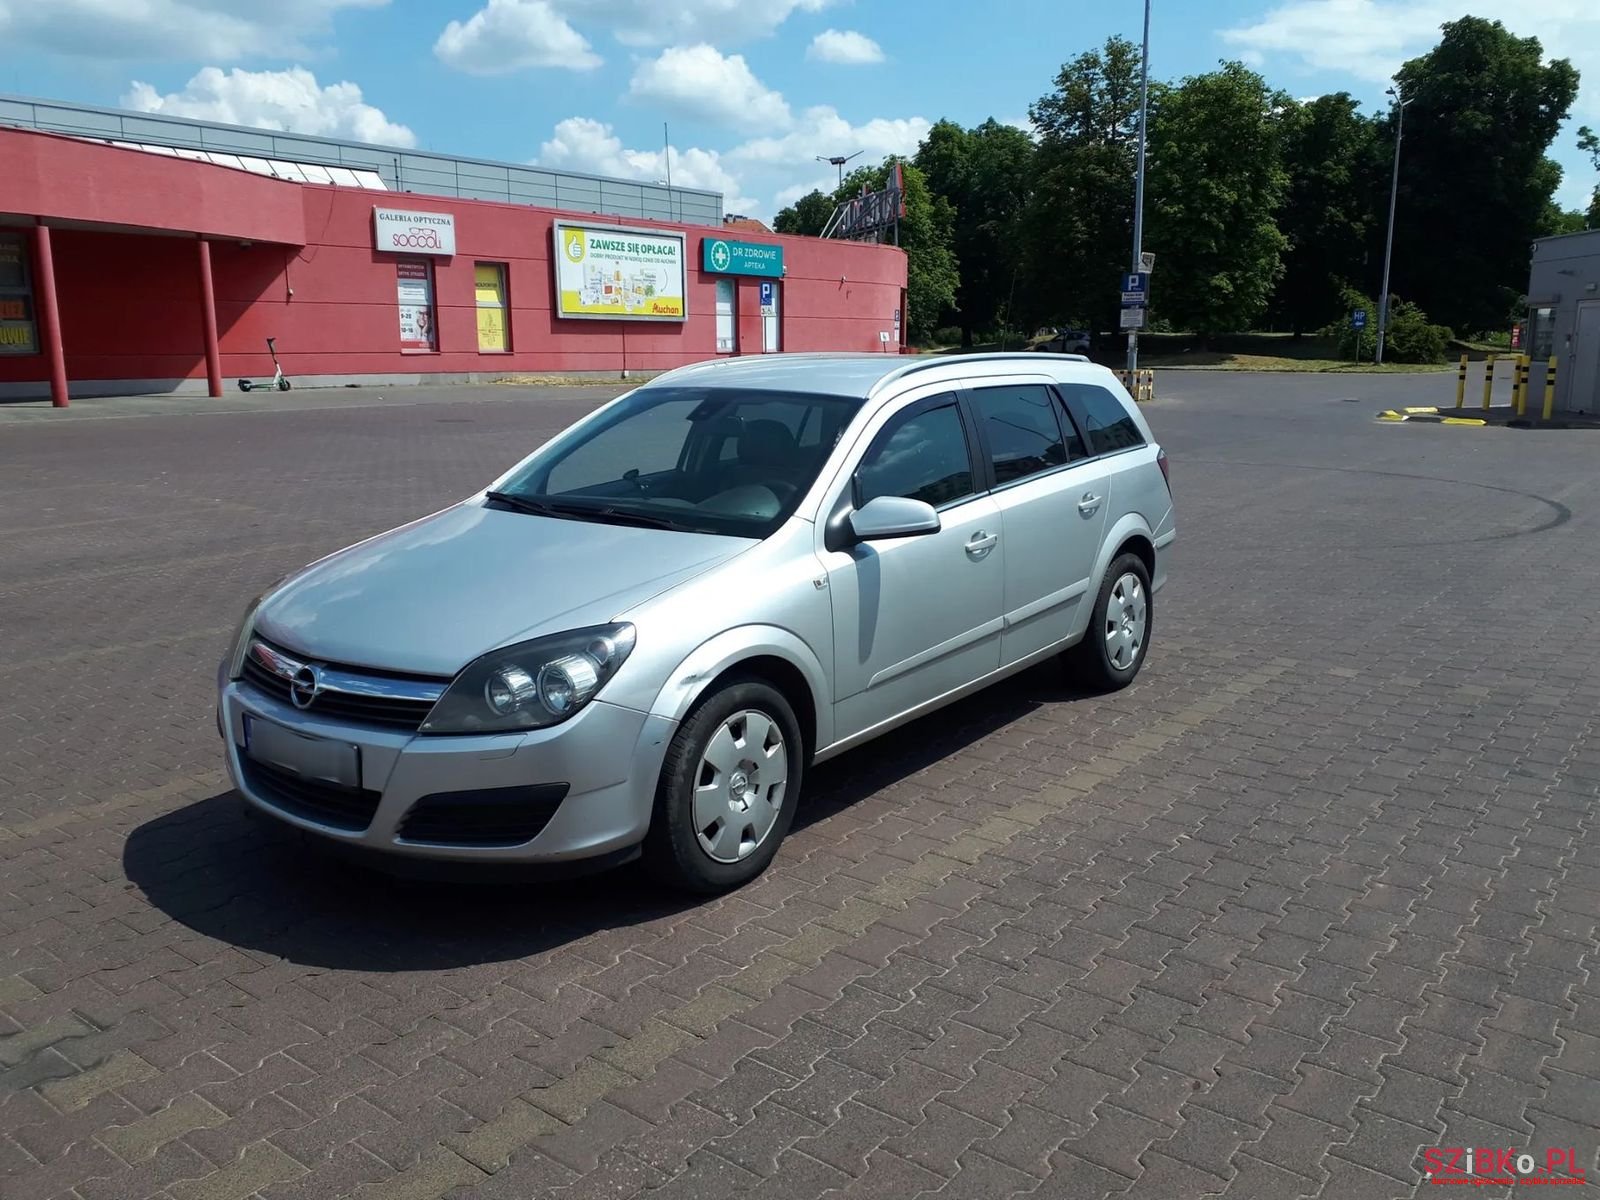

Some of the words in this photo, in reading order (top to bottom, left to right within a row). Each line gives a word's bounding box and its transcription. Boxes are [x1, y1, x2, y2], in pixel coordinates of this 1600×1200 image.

[379, 213, 412, 223] GALERIA
[413, 216, 451, 226] OPTYCZNA
[589, 239, 626, 252] ZAWSZE
[627, 242, 640, 255] SIĘ
[640, 244, 676, 256] OPŁACA!
[732, 247, 744, 257] DR
[744, 248, 776, 260] ZDROWIE
[744, 261, 766, 270] APTEKA
[1128, 275, 1139, 291] P
[762, 284, 770, 298] P
[652, 303, 679, 314] Auchan
